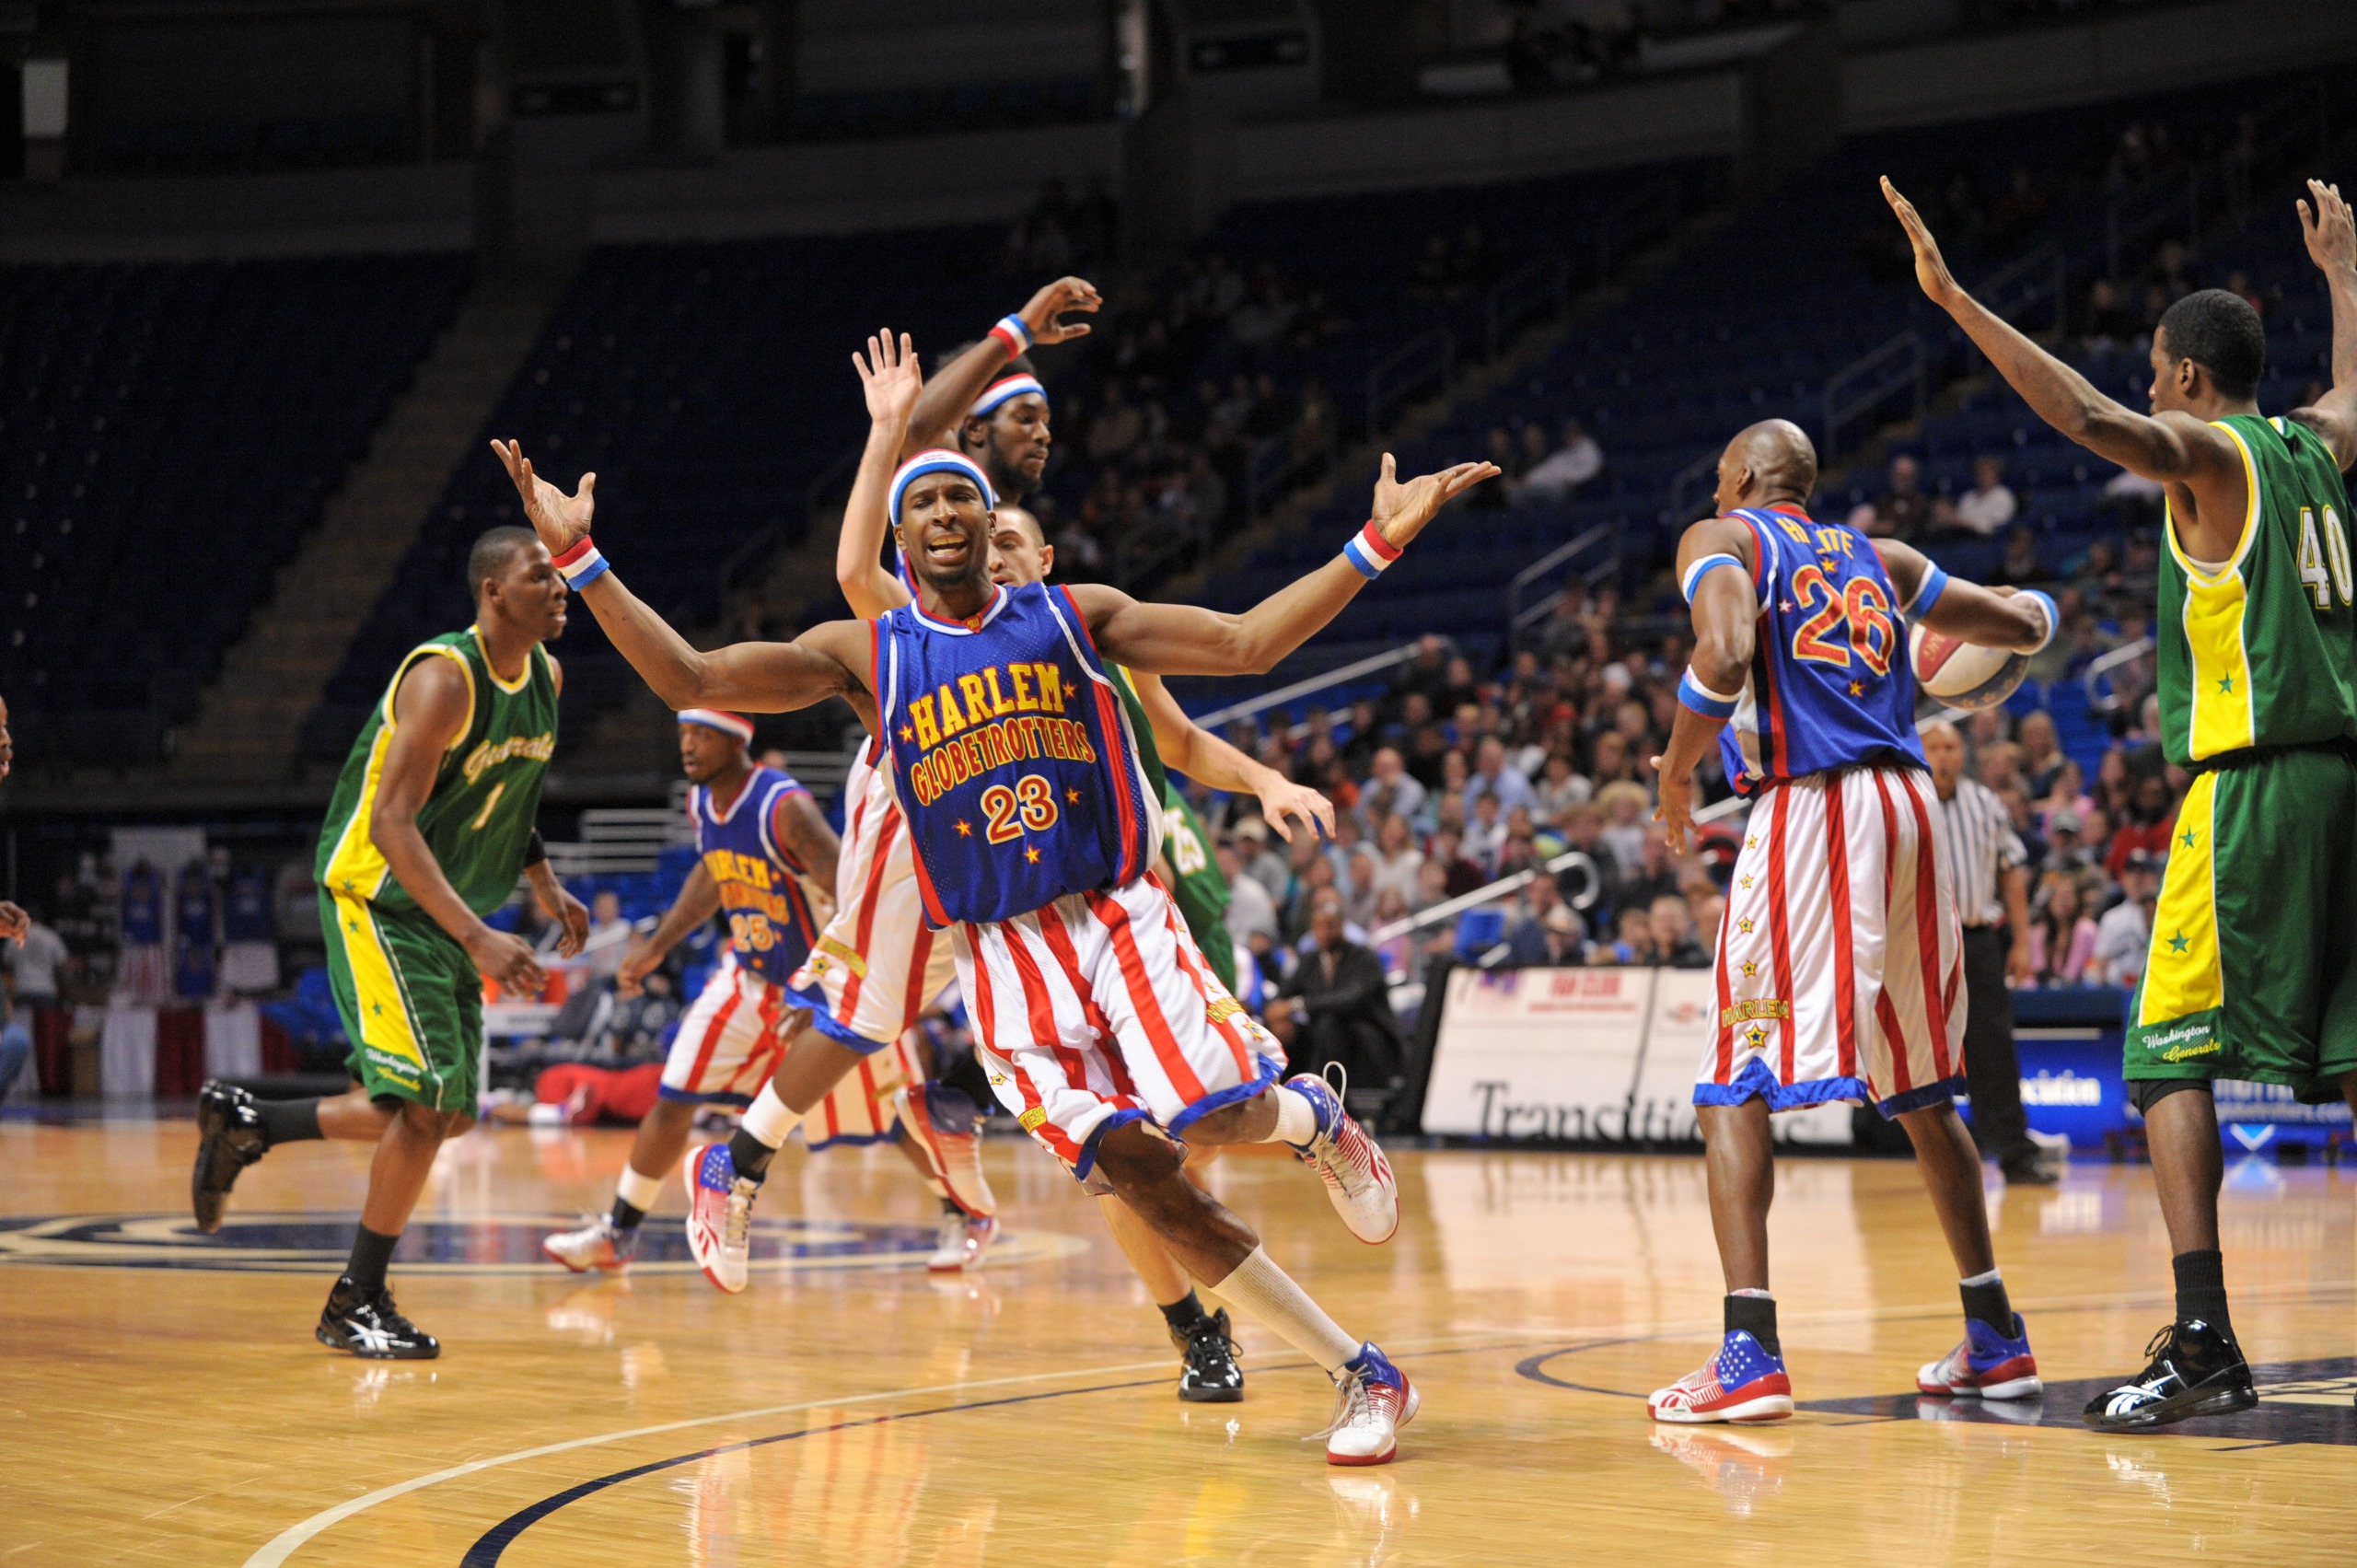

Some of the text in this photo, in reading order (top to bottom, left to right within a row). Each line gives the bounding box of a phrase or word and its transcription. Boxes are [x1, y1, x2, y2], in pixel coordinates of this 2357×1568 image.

[1775, 517, 1811, 544] HI
[2295, 504, 2353, 610] 40
[1792, 563, 1896, 677] 26
[908, 661, 1066, 752] HARLEM
[462, 731, 555, 785] Generals
[911, 716, 1097, 807] GLOBETROTTERS
[470, 781, 507, 830] 1
[980, 774, 1059, 845] 23
[1721, 999, 1790, 1028] HARLEM
[2142, 1025, 2211, 1049] Washington
[2163, 1038, 2222, 1063] Generals
